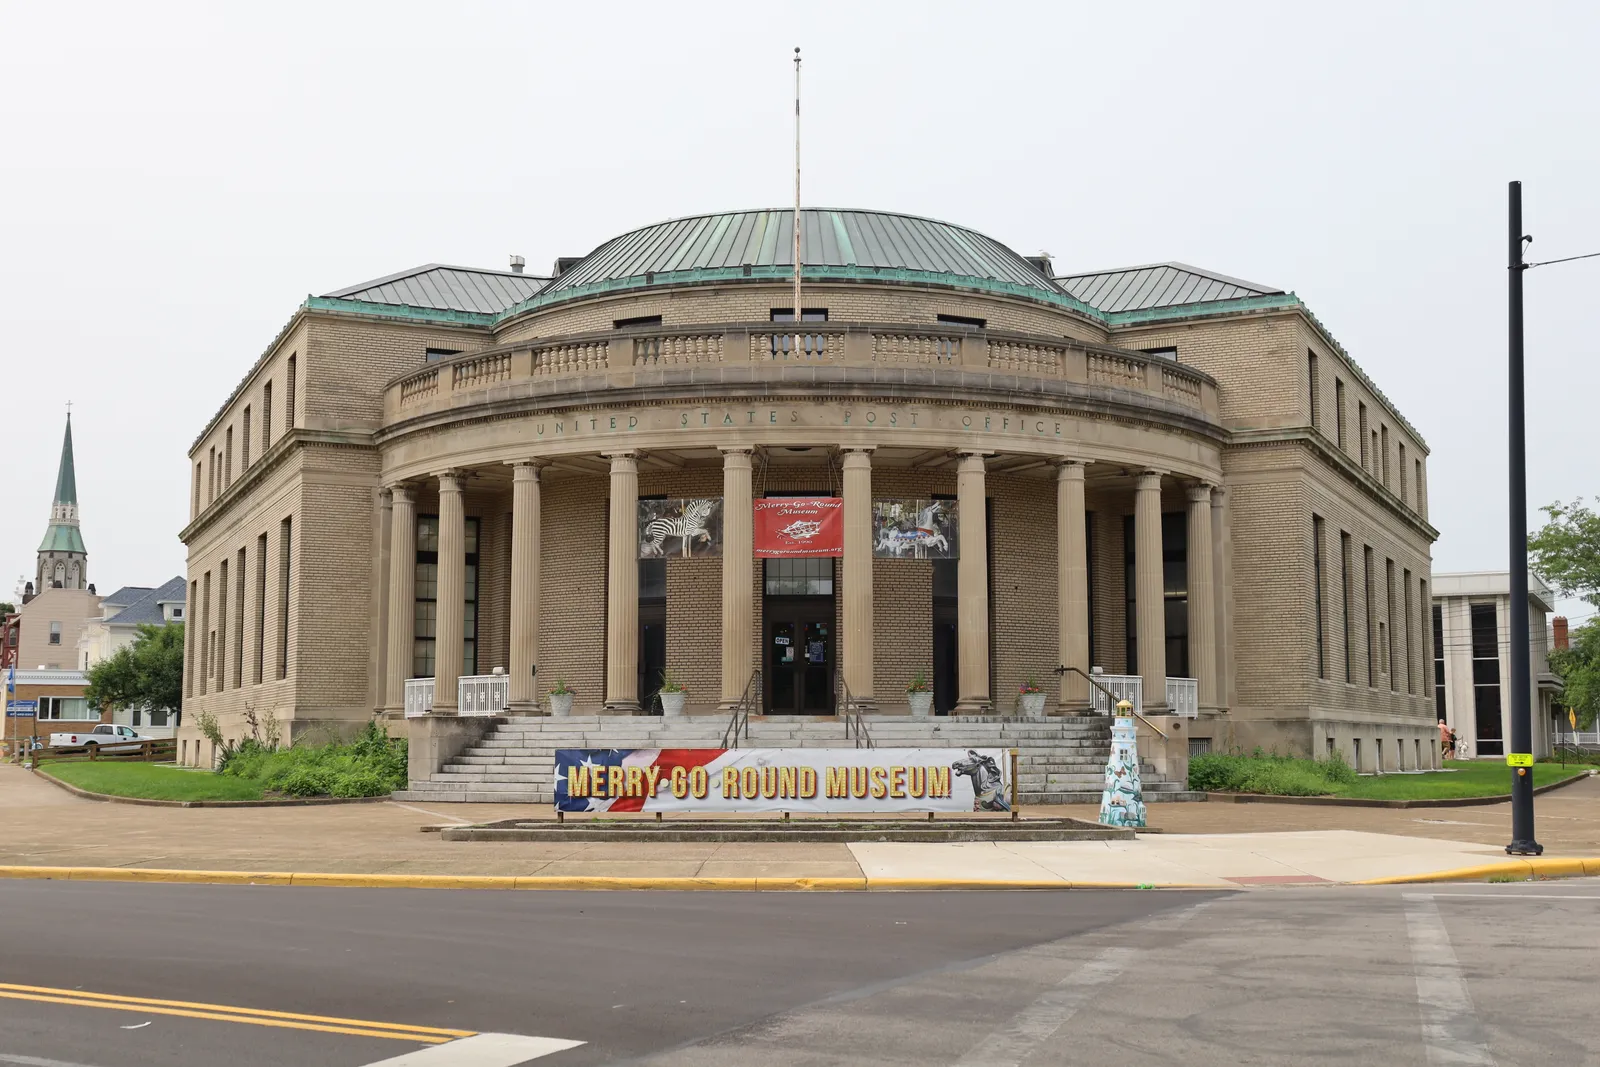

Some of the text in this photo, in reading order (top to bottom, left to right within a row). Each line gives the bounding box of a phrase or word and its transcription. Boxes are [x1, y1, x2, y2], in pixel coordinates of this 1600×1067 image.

[537, 411, 1061, 434] UNITED STATES POST OFFICE
[777, 508, 818, 516] Museum
[567, 765, 952, 799] MERRY GO ROUND MUSEUM
